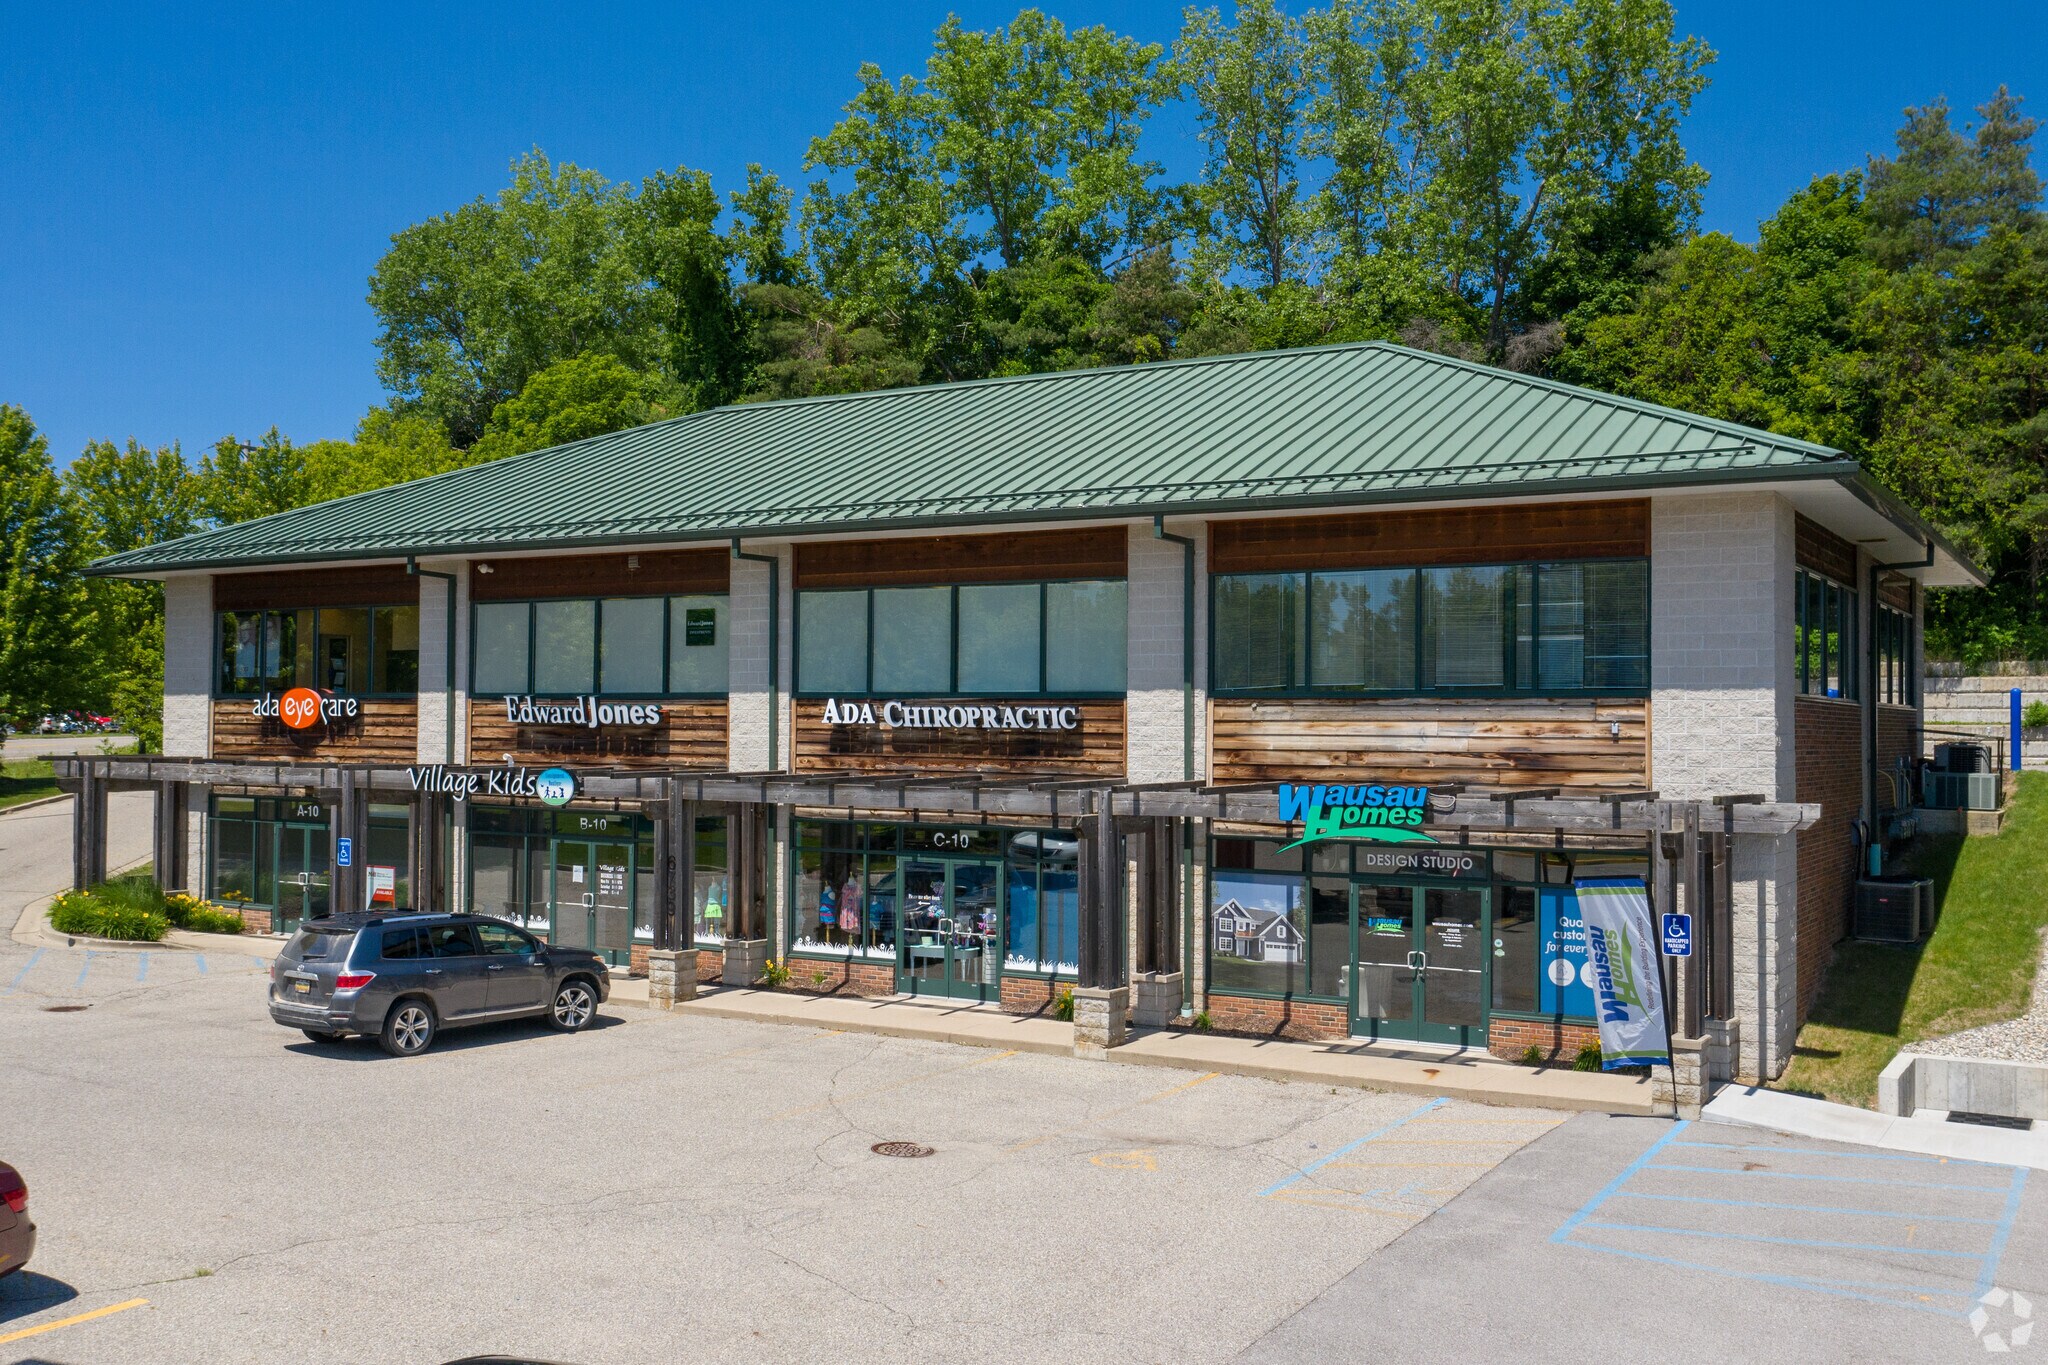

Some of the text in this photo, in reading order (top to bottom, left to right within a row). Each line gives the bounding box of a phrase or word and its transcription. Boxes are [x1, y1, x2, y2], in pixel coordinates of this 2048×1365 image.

[252, 692, 357, 726] ada eye care
[406, 765, 536, 802] Village Kids
[297, 804, 319, 817] A-10
[1278, 783, 1428, 821] Wausau
[580, 817, 607, 831] B-10
[1303, 805, 1424, 840] Homes
[933, 832, 969, 848] C-10
[1366, 853, 1473, 870] DESIGN STUDIO
[1559, 916, 1583, 928] Qua
[1553, 930, 1586, 940] custo
[1545, 941, 1589, 956] for ever
[1605, 929, 1641, 1007] Homes
[1641, 948, 1650, 971] Building
[1589, 925, 1629, 1023] Wausau
